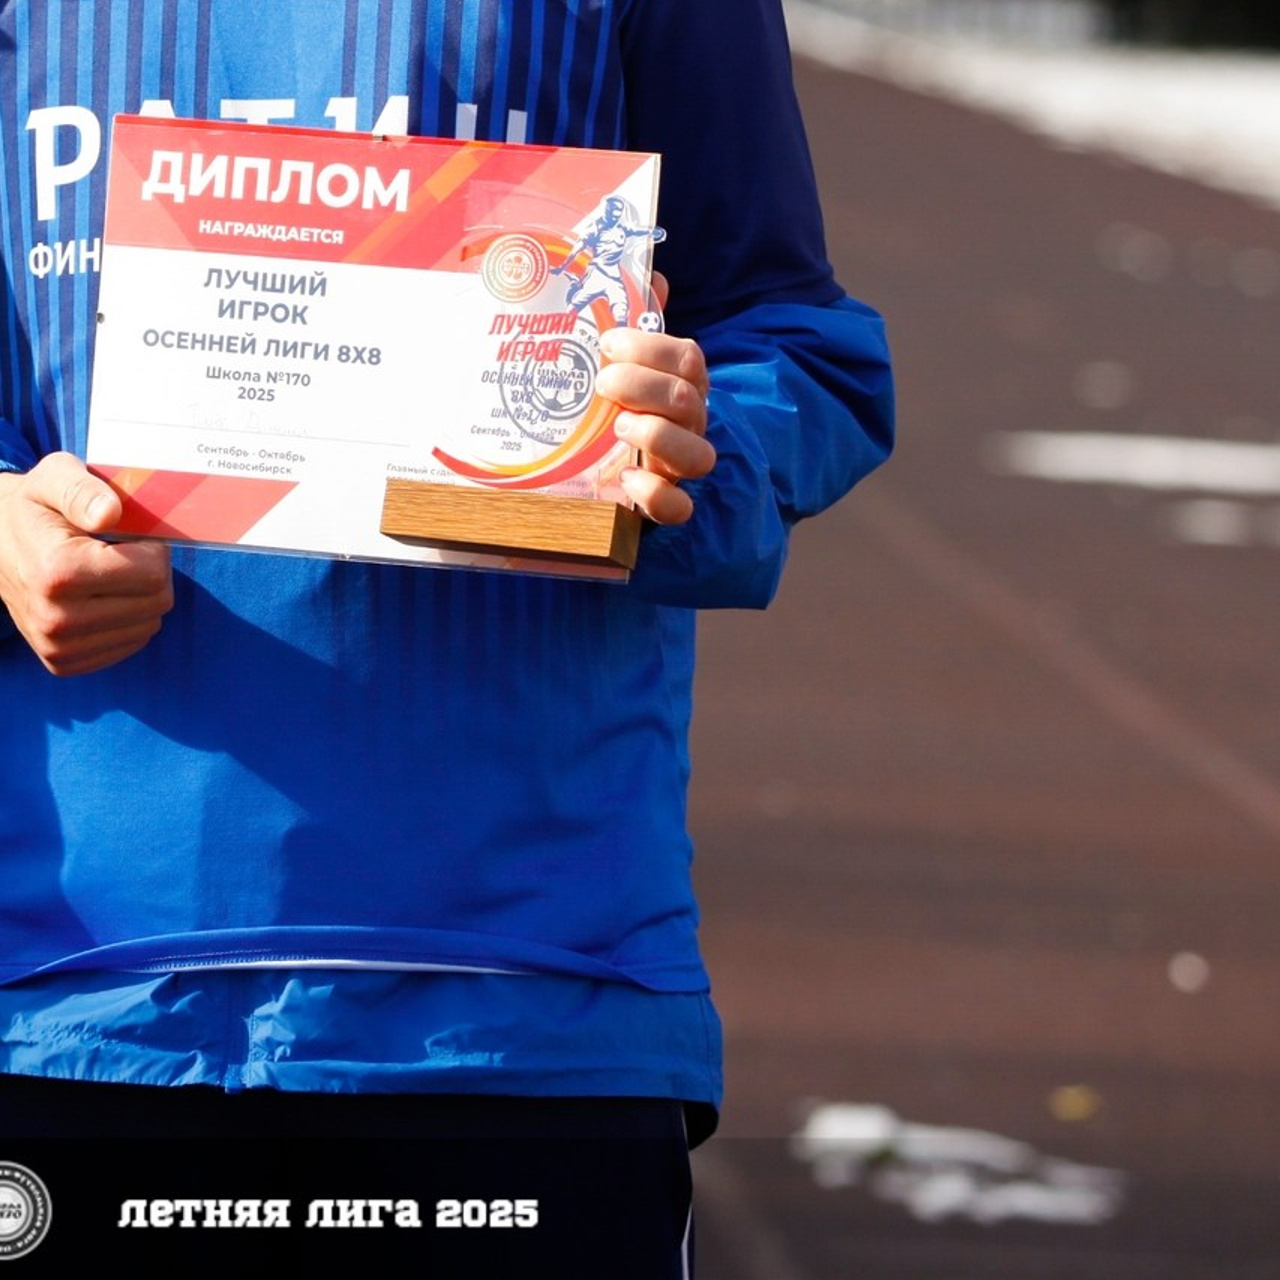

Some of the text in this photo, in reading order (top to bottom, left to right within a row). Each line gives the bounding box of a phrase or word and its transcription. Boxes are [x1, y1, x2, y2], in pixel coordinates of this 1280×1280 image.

[141, 149, 410, 213] ДИПЛОМ
[198, 219, 345, 245] НАГРАЖДАЕТСЯ
[204, 268, 328, 297] ЛУЧШИЙ
[217, 298, 309, 326] ИГРОК
[142, 328, 383, 366] ОСЕННЕЙ ЛИГИ 8Х8
[205, 365, 312, 387] Школа №170
[237, 386, 276, 402] 2025
[197, 443, 249, 458] Сентябрь
[258, 449, 306, 463] Октябрь
[218, 460, 293, 475] Новосибирск
